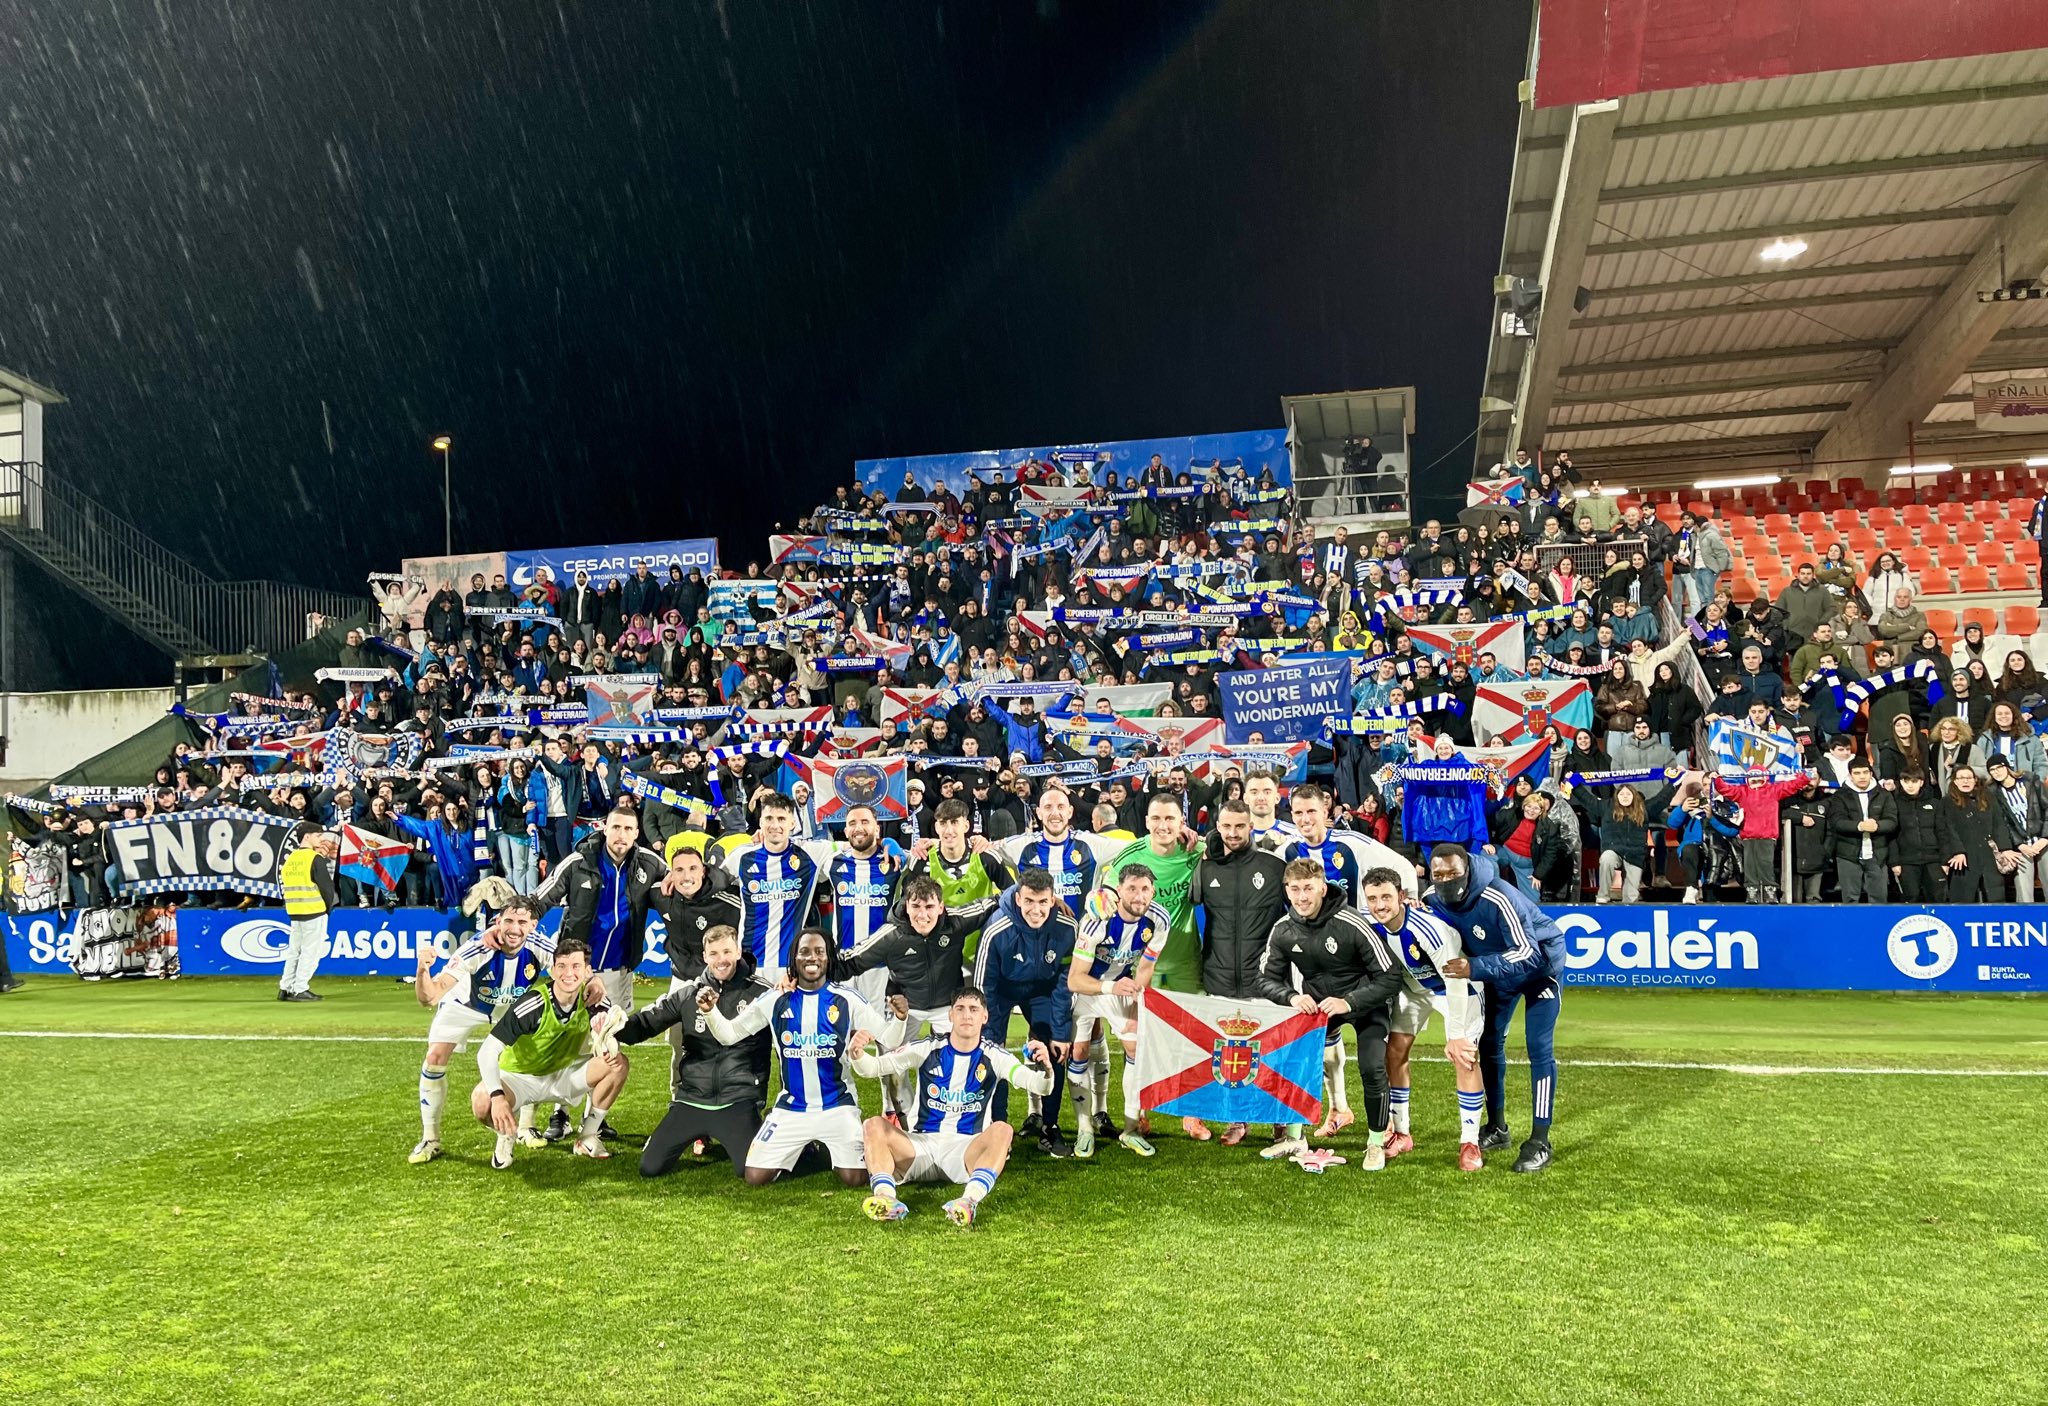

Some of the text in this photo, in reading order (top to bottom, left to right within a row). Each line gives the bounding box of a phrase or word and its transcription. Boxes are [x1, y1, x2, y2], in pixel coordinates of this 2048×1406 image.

[1988, 384, 2028, 398] PEÑA
[563, 552, 709, 572] CESAR DORADO
[1200, 603, 1251, 614] SDPONFERRADINA
[1145, 613, 1231, 624] ORGULLO BERCIANO
[1140, 631, 1193, 645] SDPONFERRADINA
[827, 658, 876, 667] SDPONFERRADINA
[1230, 664, 1340, 687] AND AFTER ALL...
[1234, 679, 1339, 706] YOU'RE MY
[541, 710, 588, 719] SDPONFERRADIN
[659, 709, 728, 718] PONFERRADINA
[1235, 700, 1343, 724] WONDERWALL
[1400, 768, 1485, 781] SDPONFERRADINA
[112, 821, 199, 882] FN
[205, 819, 274, 879] 86
[1159, 880, 1190, 898] tvite
[751, 890, 801, 903] CRICURSA
[838, 896, 888, 907] CRICURSA
[1554, 909, 1759, 970] Galén
[1964, 921, 2048, 947] TERN
[1566, 973, 1716, 985] CENTRO EDUCATIVO
[783, 1048, 837, 1058] CRICURSA
[927, 1099, 982, 1113] CRICURSA
[756, 1123, 778, 1142] 16
